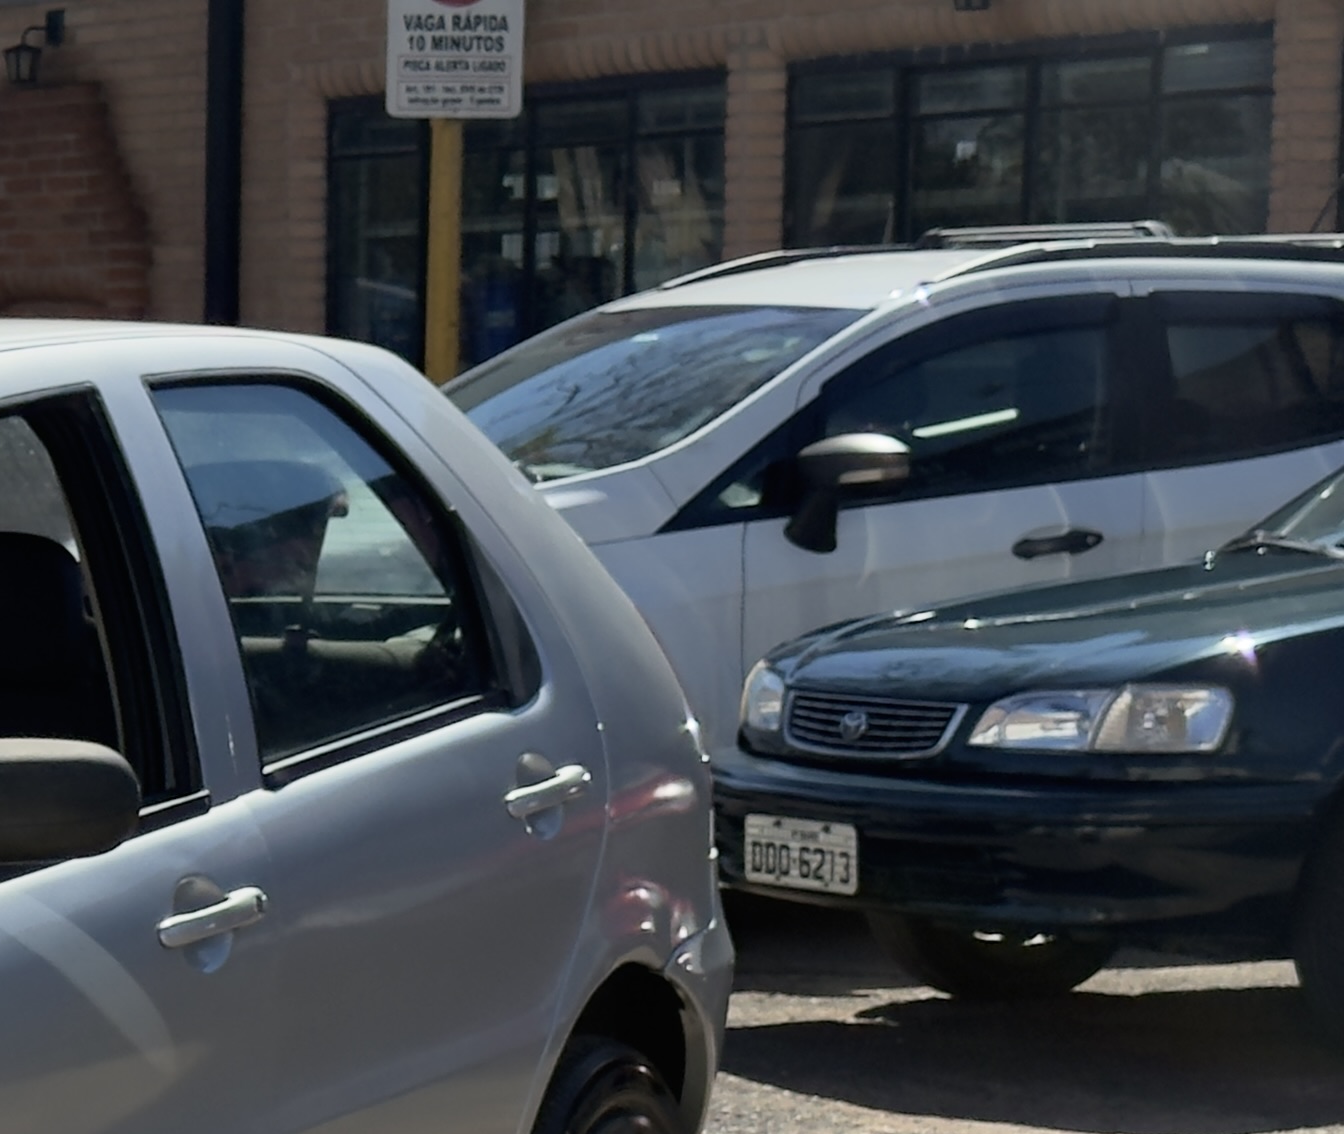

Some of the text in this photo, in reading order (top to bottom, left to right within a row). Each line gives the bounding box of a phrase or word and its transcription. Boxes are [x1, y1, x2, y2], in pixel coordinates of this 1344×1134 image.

[403, 9, 509, 33] VAGA RÁPIDA
[409, 35, 505, 53] 10 MINUTOS
